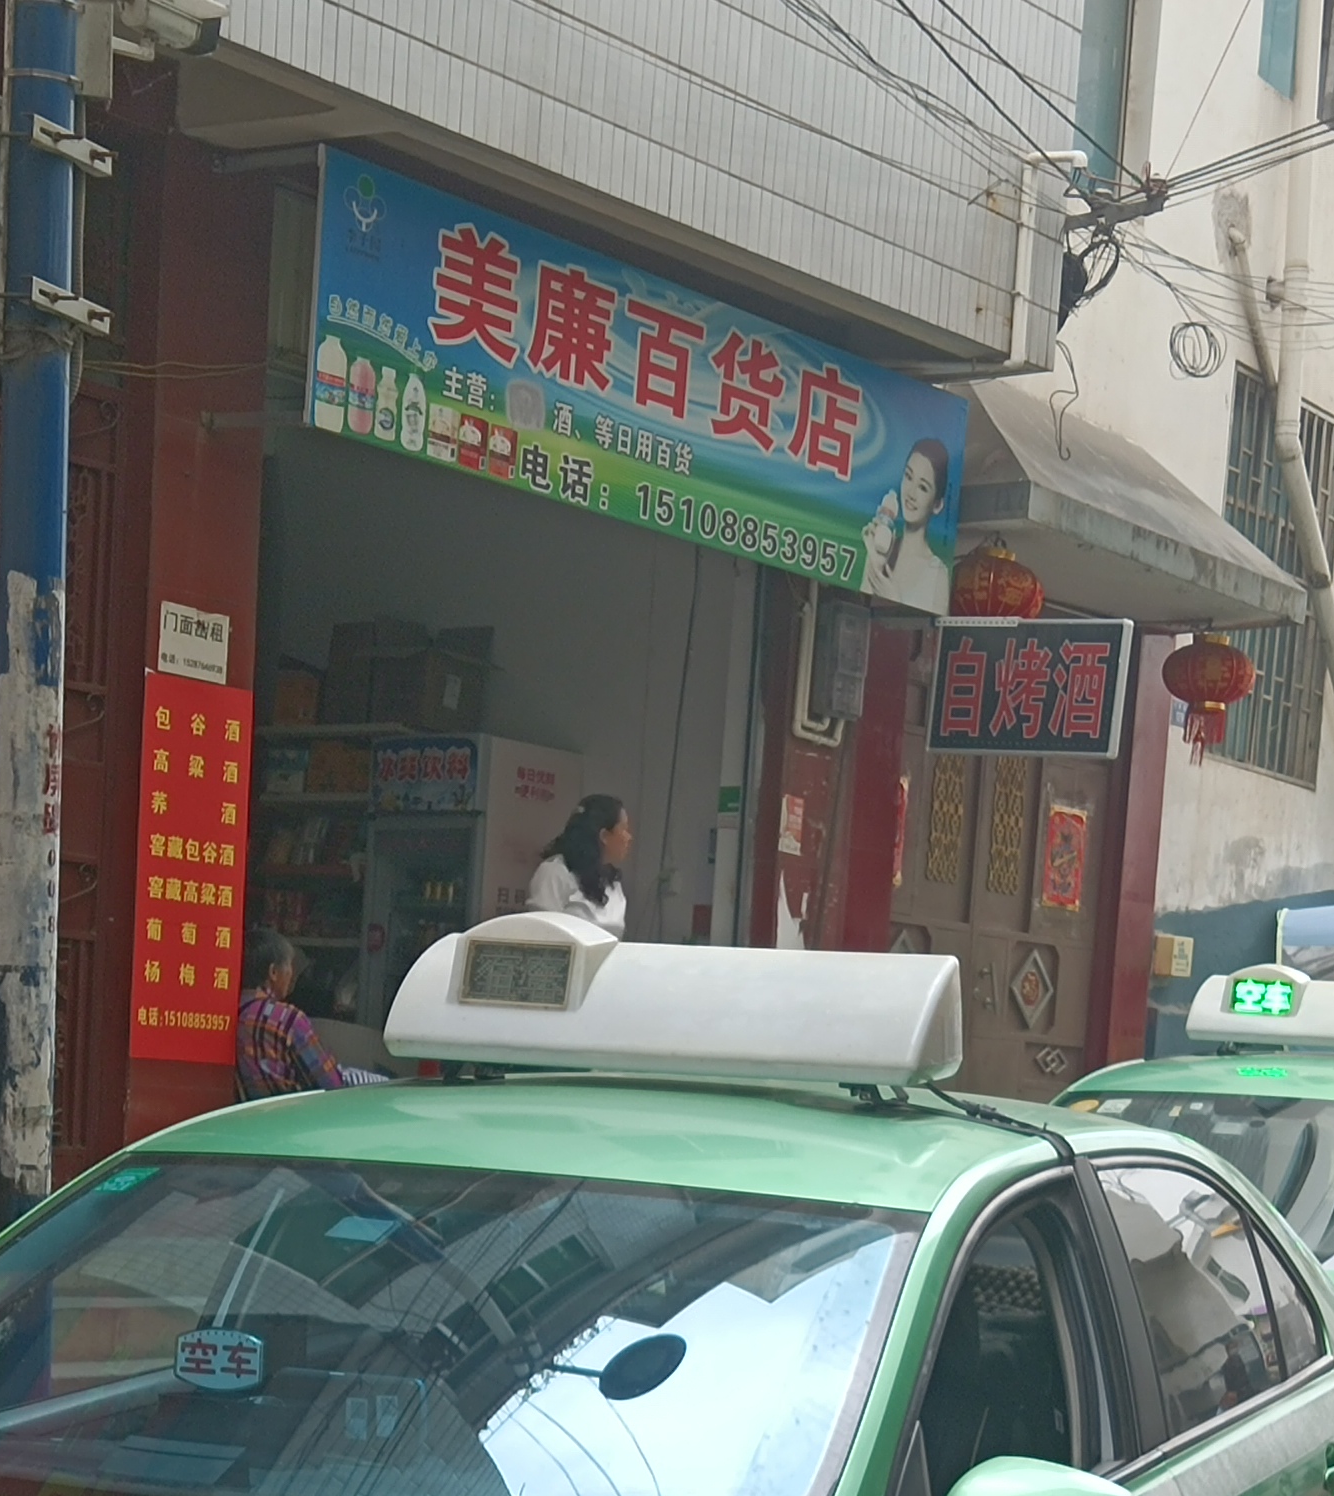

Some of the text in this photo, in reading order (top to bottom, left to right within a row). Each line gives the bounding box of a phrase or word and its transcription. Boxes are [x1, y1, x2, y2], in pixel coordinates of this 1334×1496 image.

[426, 222, 863, 480] 美廉百货店
[939, 636, 1111, 739] 自烤酒
[155, 705, 241, 743] 包谷酒
[146, 917, 231, 949] 葡萄酒
[144, 959, 229, 990] 杨梅酒
[1233, 978, 1292, 1015] 空车
[180, 1338, 258, 1379] 空车
